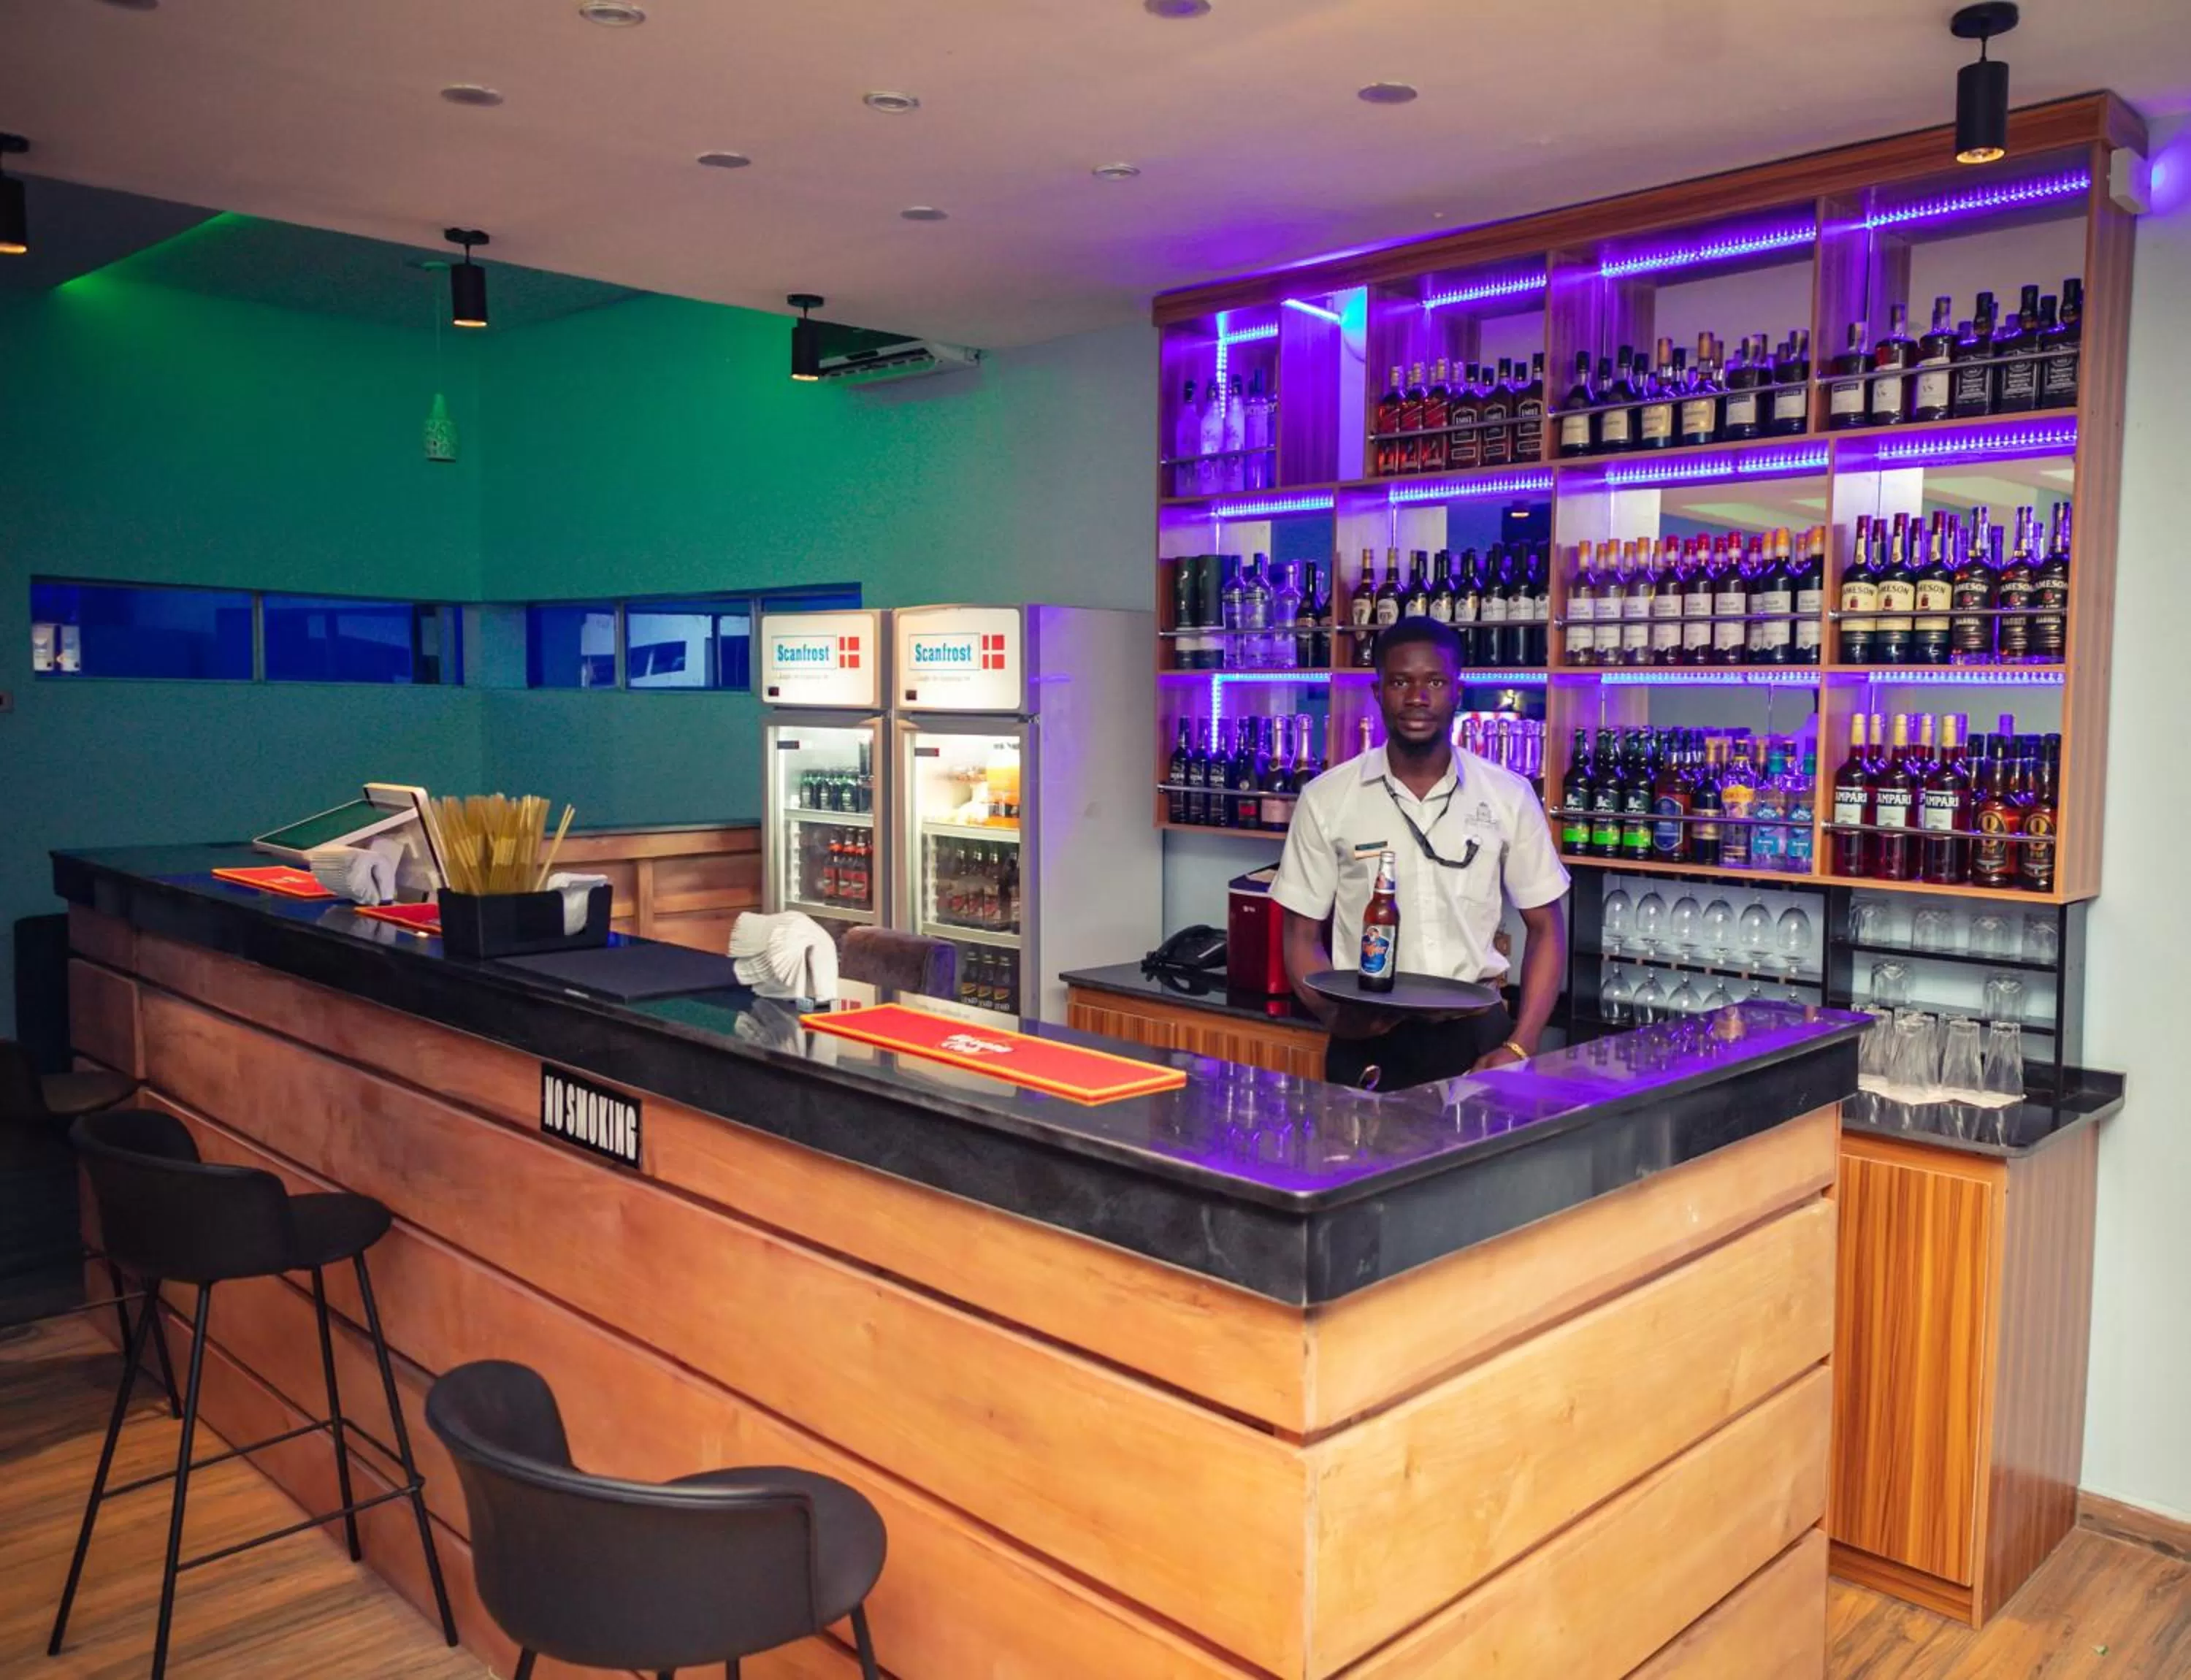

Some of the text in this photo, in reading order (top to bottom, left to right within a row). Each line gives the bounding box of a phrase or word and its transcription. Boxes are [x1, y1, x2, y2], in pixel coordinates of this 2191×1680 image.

[778, 644, 830, 662] Scanfrost
[915, 643, 971, 662] Scanfrost
[545, 1075, 637, 1160] NO SMOKING
